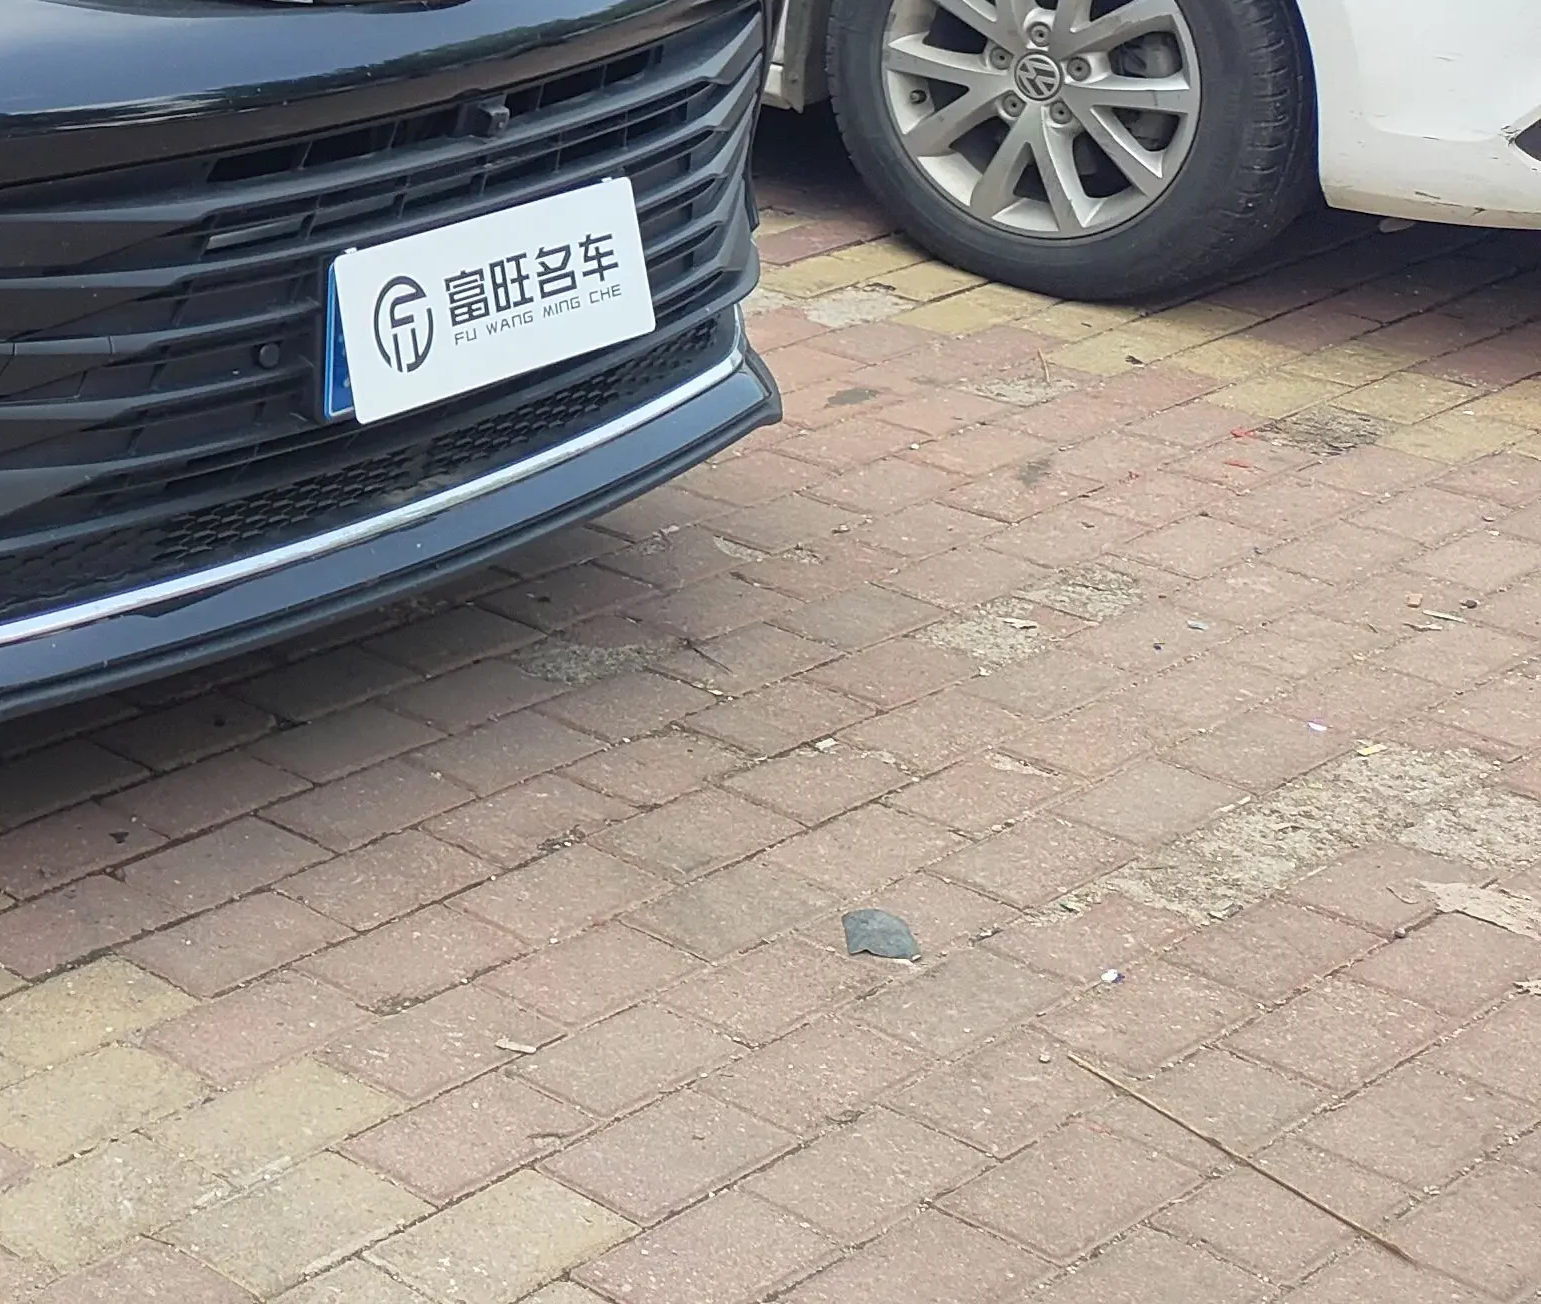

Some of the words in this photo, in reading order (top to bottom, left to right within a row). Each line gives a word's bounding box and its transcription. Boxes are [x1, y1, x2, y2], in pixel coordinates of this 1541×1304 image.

[444, 233, 619, 328] 富旺名车
[454, 327, 478, 346] FU
[486, 311, 534, 336] WANG
[543, 297, 581, 319] MING
[589, 284, 622, 304] CHE
